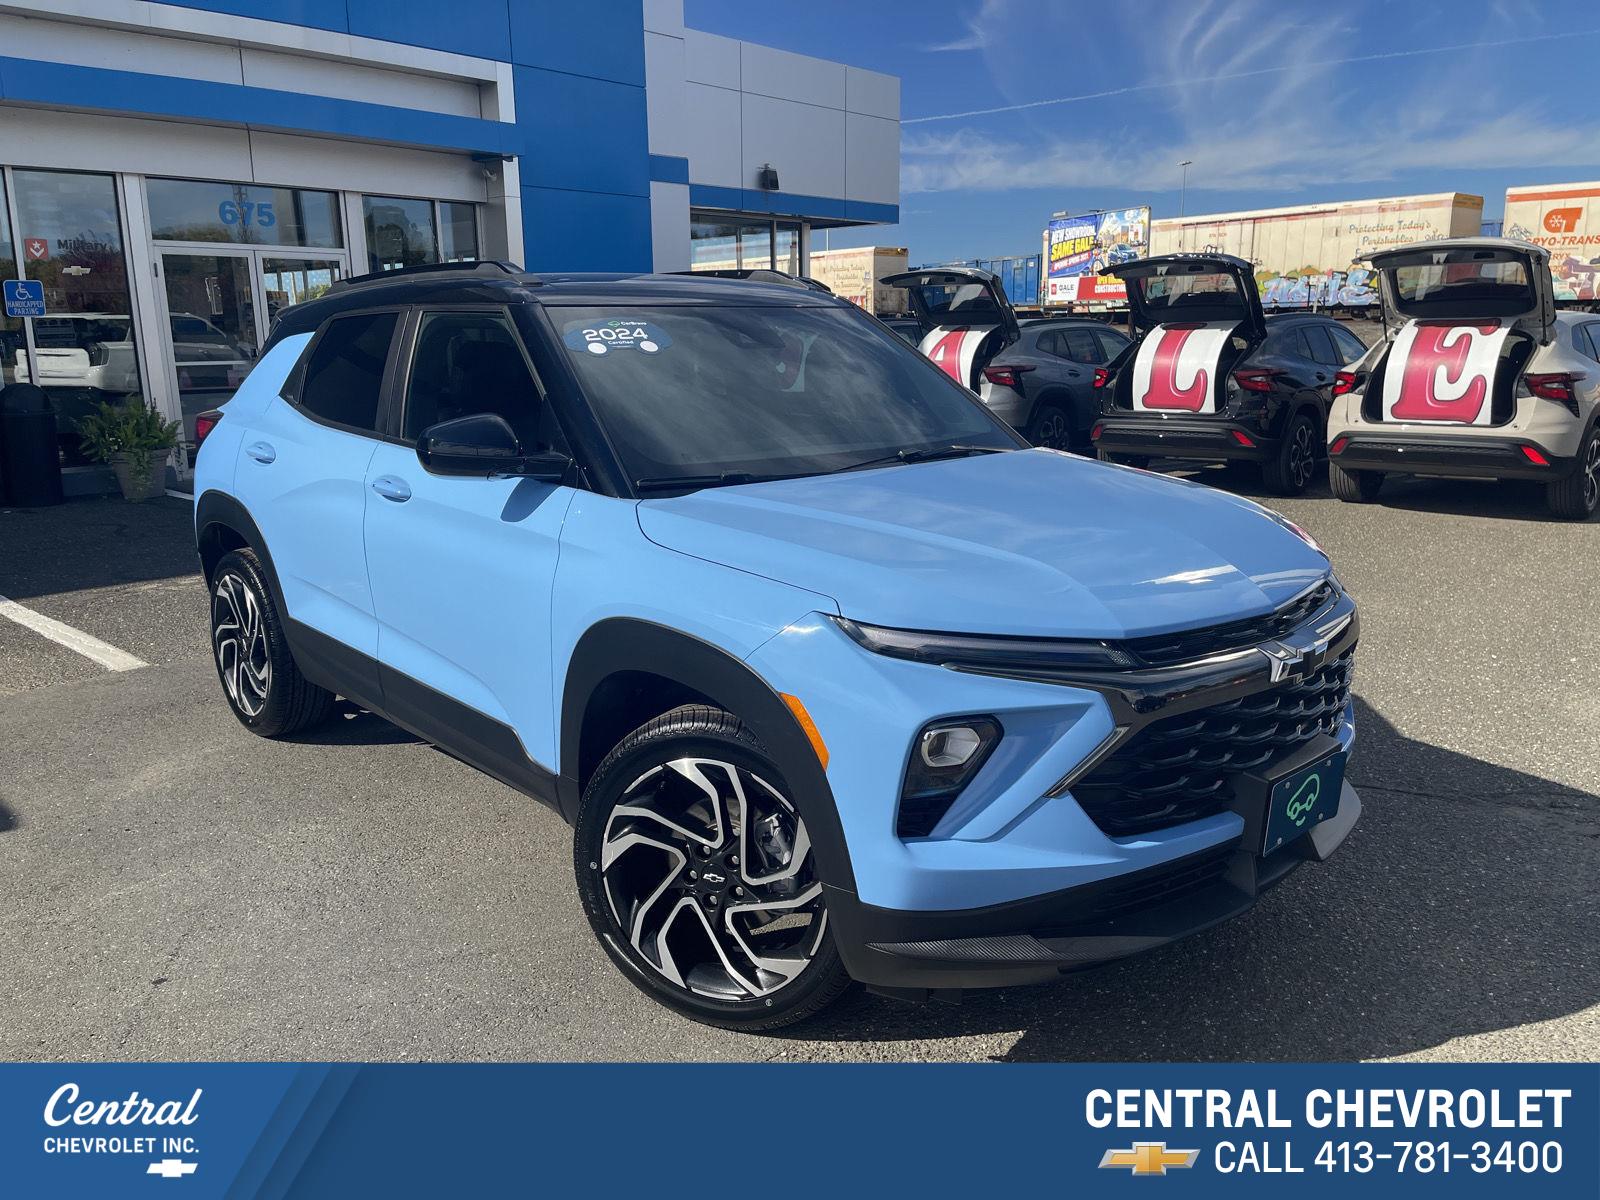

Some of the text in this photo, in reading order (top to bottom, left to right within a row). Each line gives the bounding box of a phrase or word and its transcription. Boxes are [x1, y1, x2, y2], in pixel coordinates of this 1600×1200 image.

[218, 200, 276, 227] 675
[1349, 223, 1394, 234] Protecting
[57, 238, 107, 252] Military
[1051, 239, 1075, 262] SAME
[7, 300, 44, 308] HANDICAPPED
[14, 307, 39, 315] PARKING
[582, 328, 648, 341] 2024
[1141, 322, 1208, 412] L
[1390, 319, 1502, 424] E
